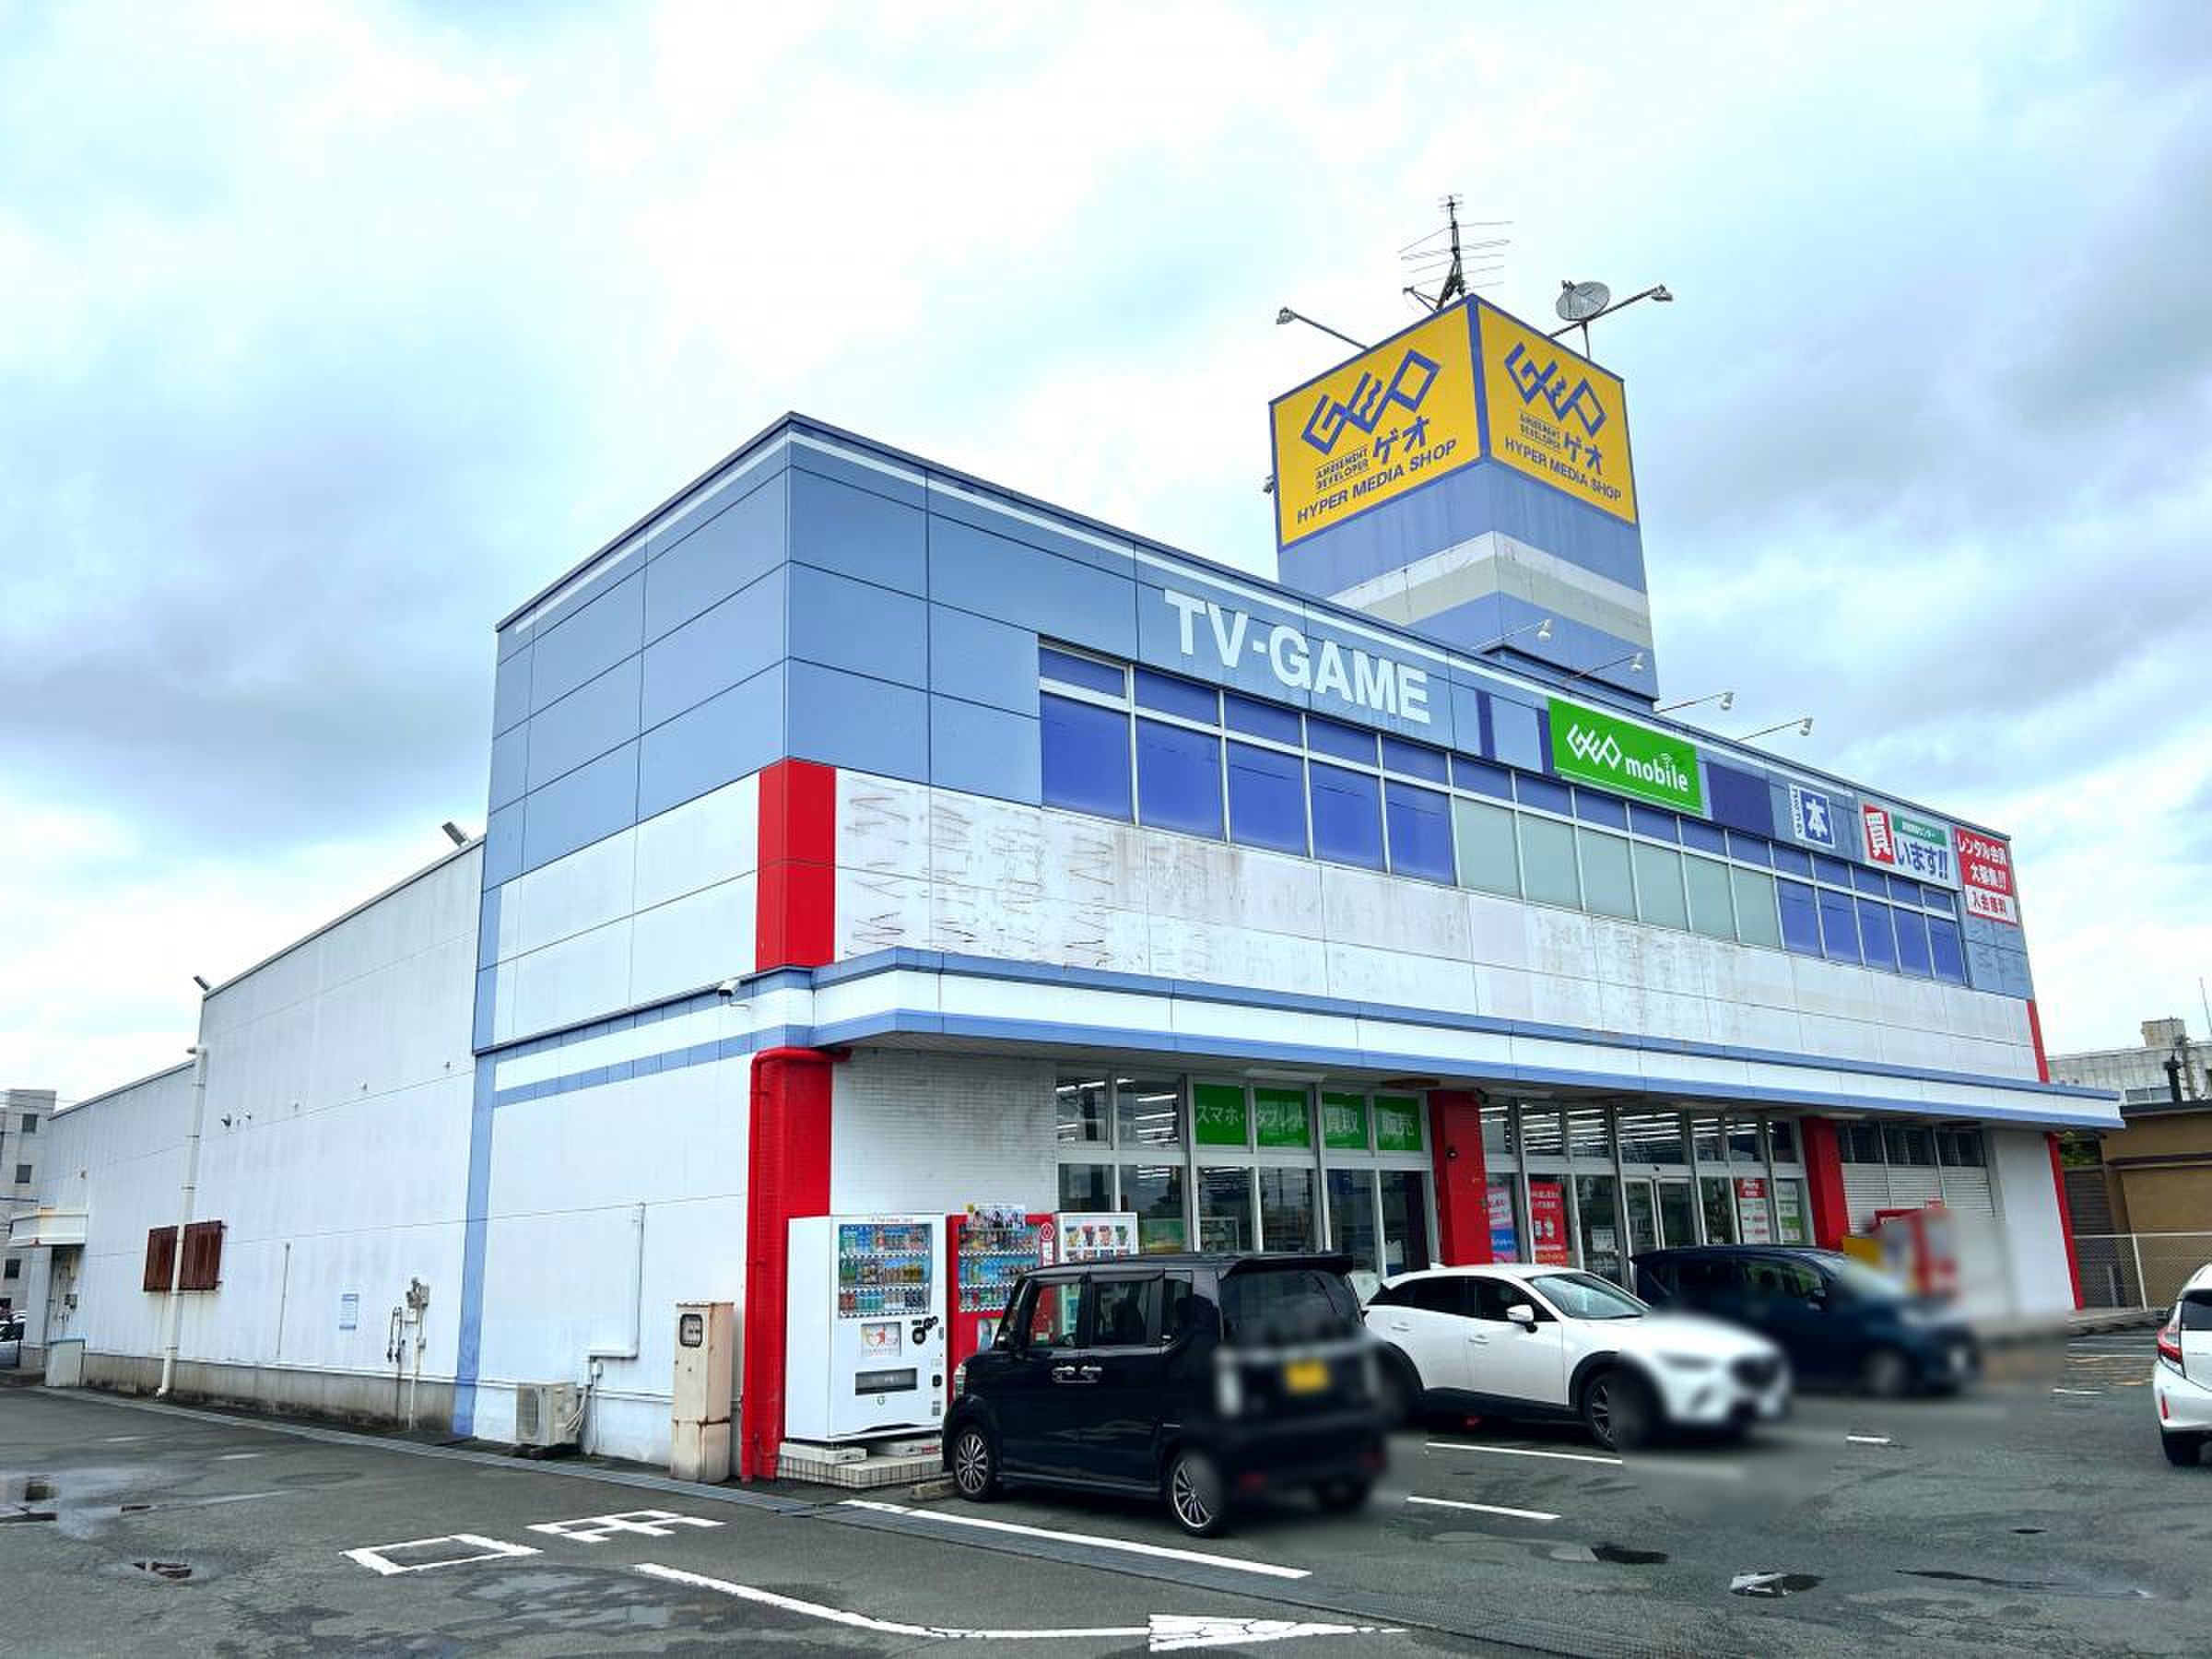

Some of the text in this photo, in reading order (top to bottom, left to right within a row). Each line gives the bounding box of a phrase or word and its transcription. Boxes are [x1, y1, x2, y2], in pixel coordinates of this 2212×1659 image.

[1373, 415, 1430, 466] ゲオ
[1563, 430, 1603, 476] ゲオ
[1297, 439, 1456, 524] HYPER MEDIA SHOP
[1504, 435, 1622, 502] HYPER MEDIA SHOP
[1164, 588, 1432, 725] TV-GAME
[1625, 752, 1688, 793] mobile
[1806, 798, 1828, 838] 本
